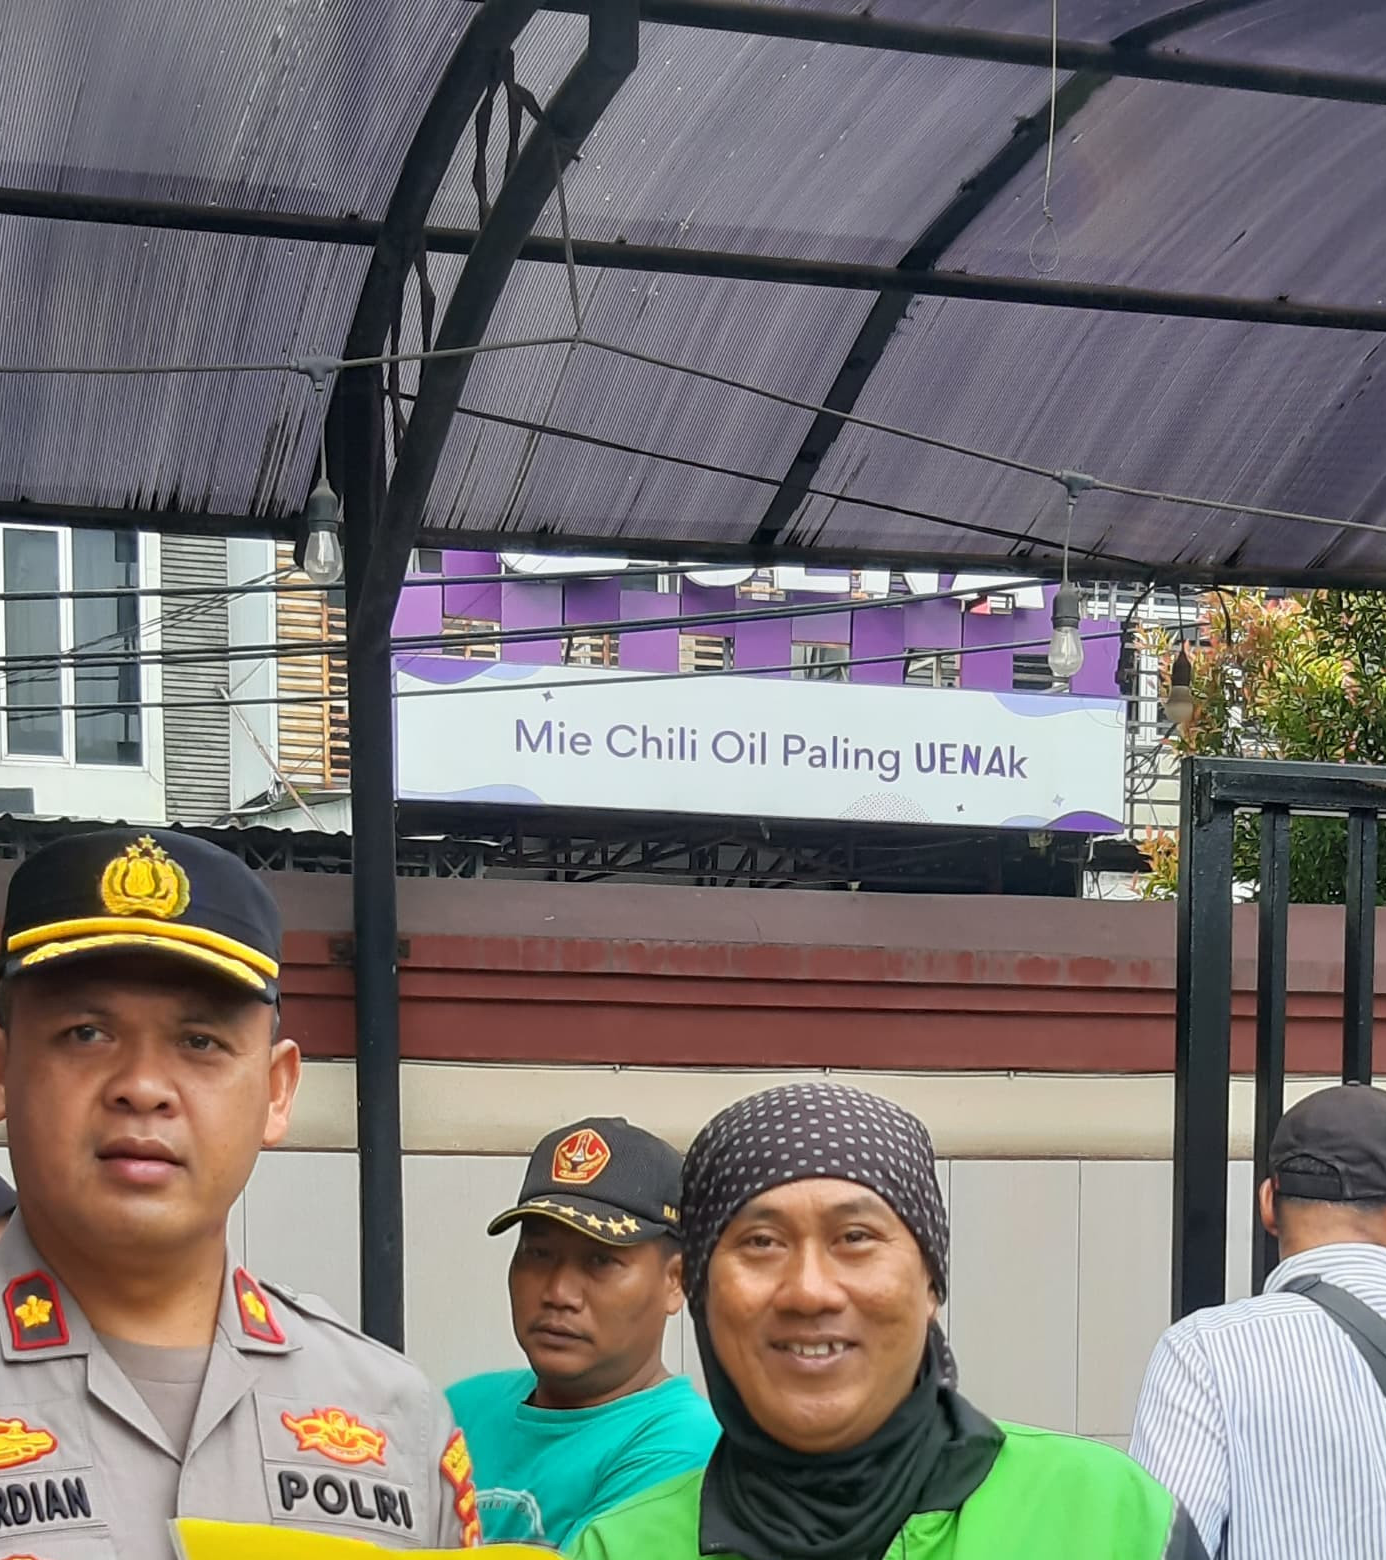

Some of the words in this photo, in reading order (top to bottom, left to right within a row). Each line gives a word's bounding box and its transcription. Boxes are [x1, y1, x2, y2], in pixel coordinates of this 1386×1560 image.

[514, 718, 593, 757] Mie
[605, 723, 699, 762] Chili
[711, 730, 769, 766] Oil
[782, 734, 901, 783] Paling
[914, 741, 1029, 780] UENAk
[278, 1470, 413, 1530] POLRI
